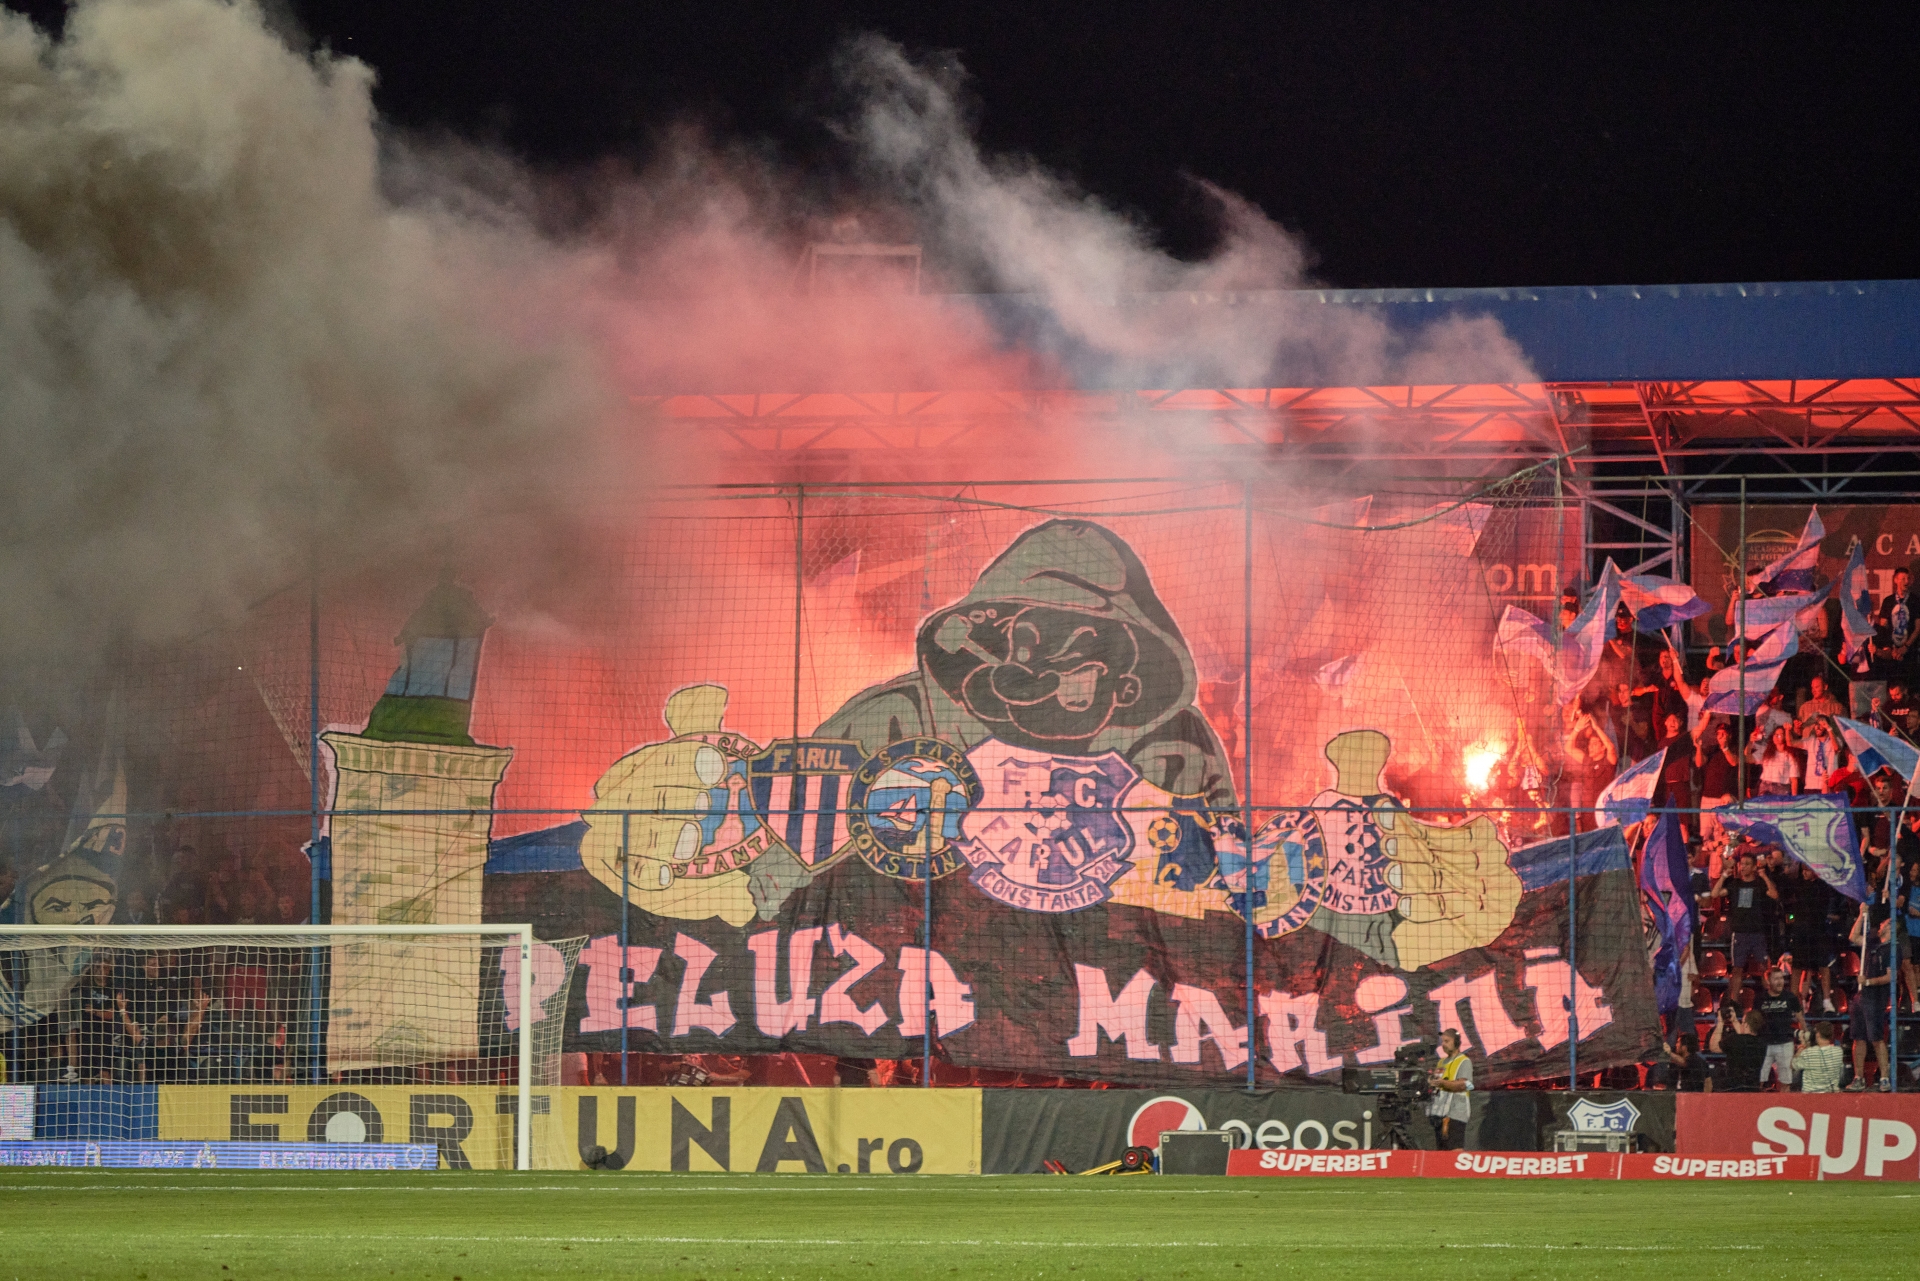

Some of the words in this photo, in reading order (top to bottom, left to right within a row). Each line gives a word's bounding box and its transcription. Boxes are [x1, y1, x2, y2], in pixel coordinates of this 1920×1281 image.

[772, 747, 849, 770] FARUL
[981, 872, 1100, 910] CONSTANTA
[230, 1092, 924, 1174] FORTUNA.ro
[1752, 1106, 1918, 1177] SUP
[1259, 1151, 1392, 1172] SUPERBET
[1455, 1153, 1587, 1176] SUPERBET
[1653, 1155, 1788, 1178] SUPERBET
